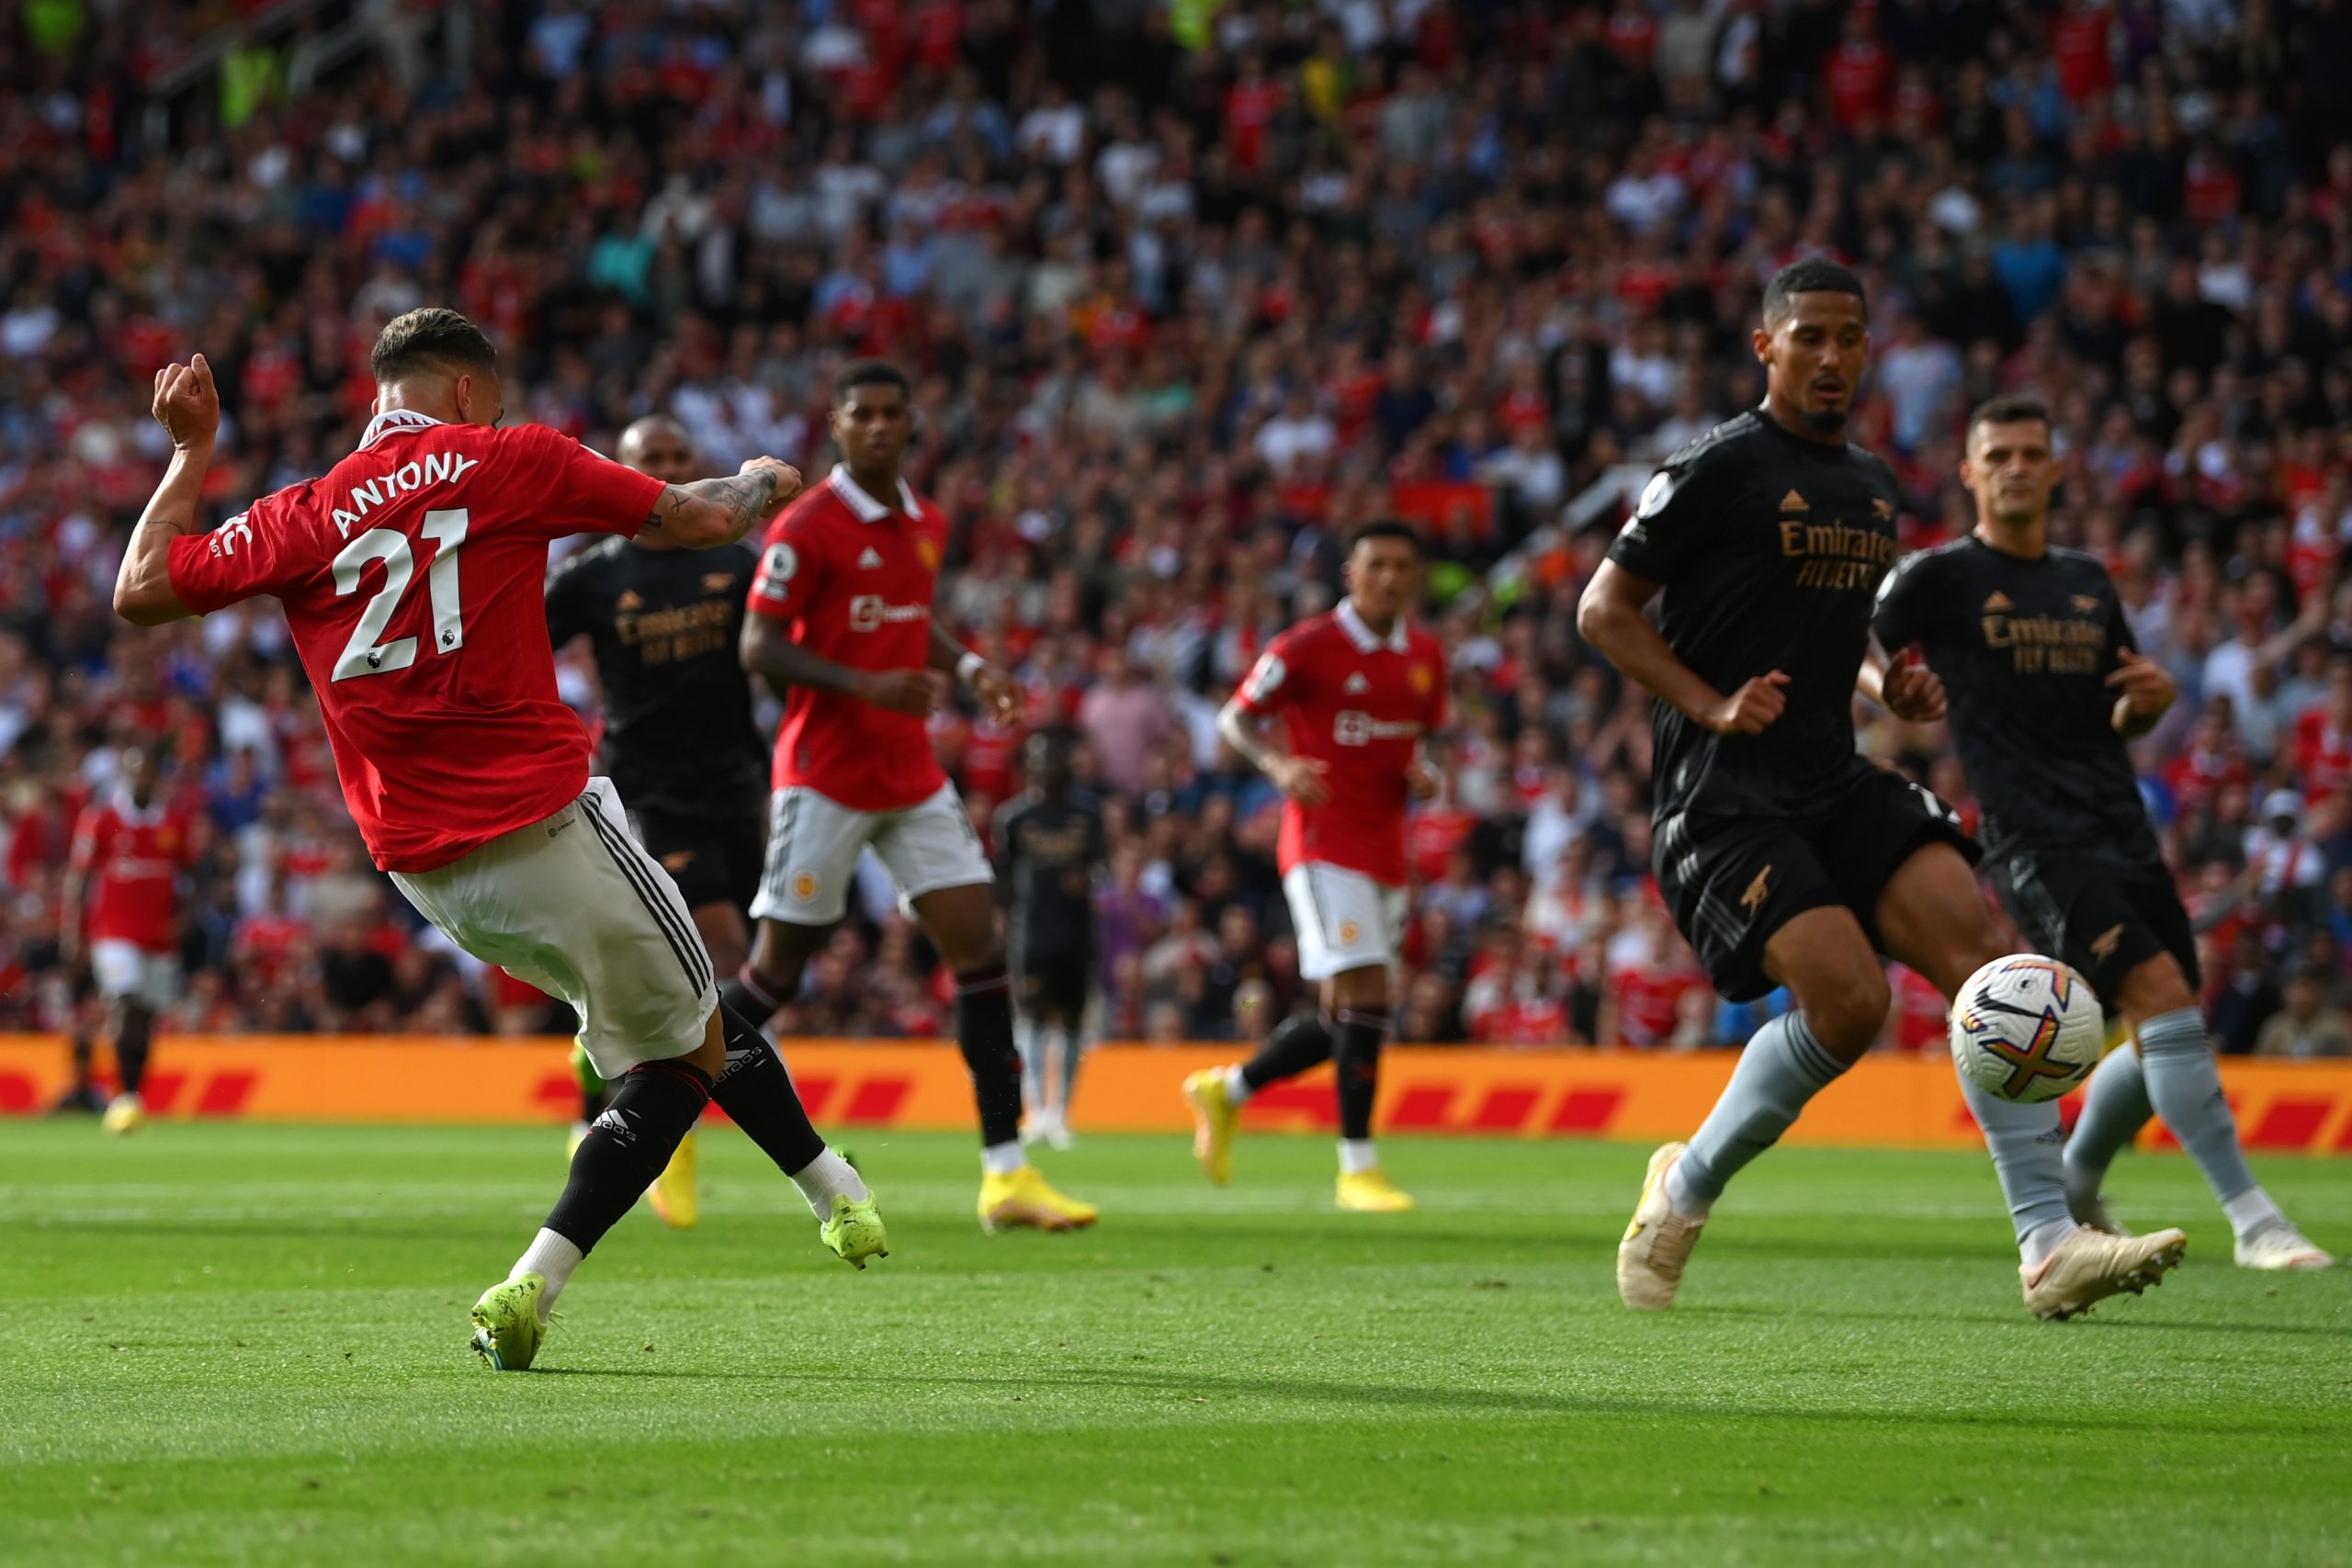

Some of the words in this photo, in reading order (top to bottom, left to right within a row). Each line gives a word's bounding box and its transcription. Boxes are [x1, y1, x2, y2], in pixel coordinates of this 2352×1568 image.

[332, 452, 479, 539] ANTONY
[1779, 520, 1894, 563] Emirate
[331, 508, 469, 682] 21
